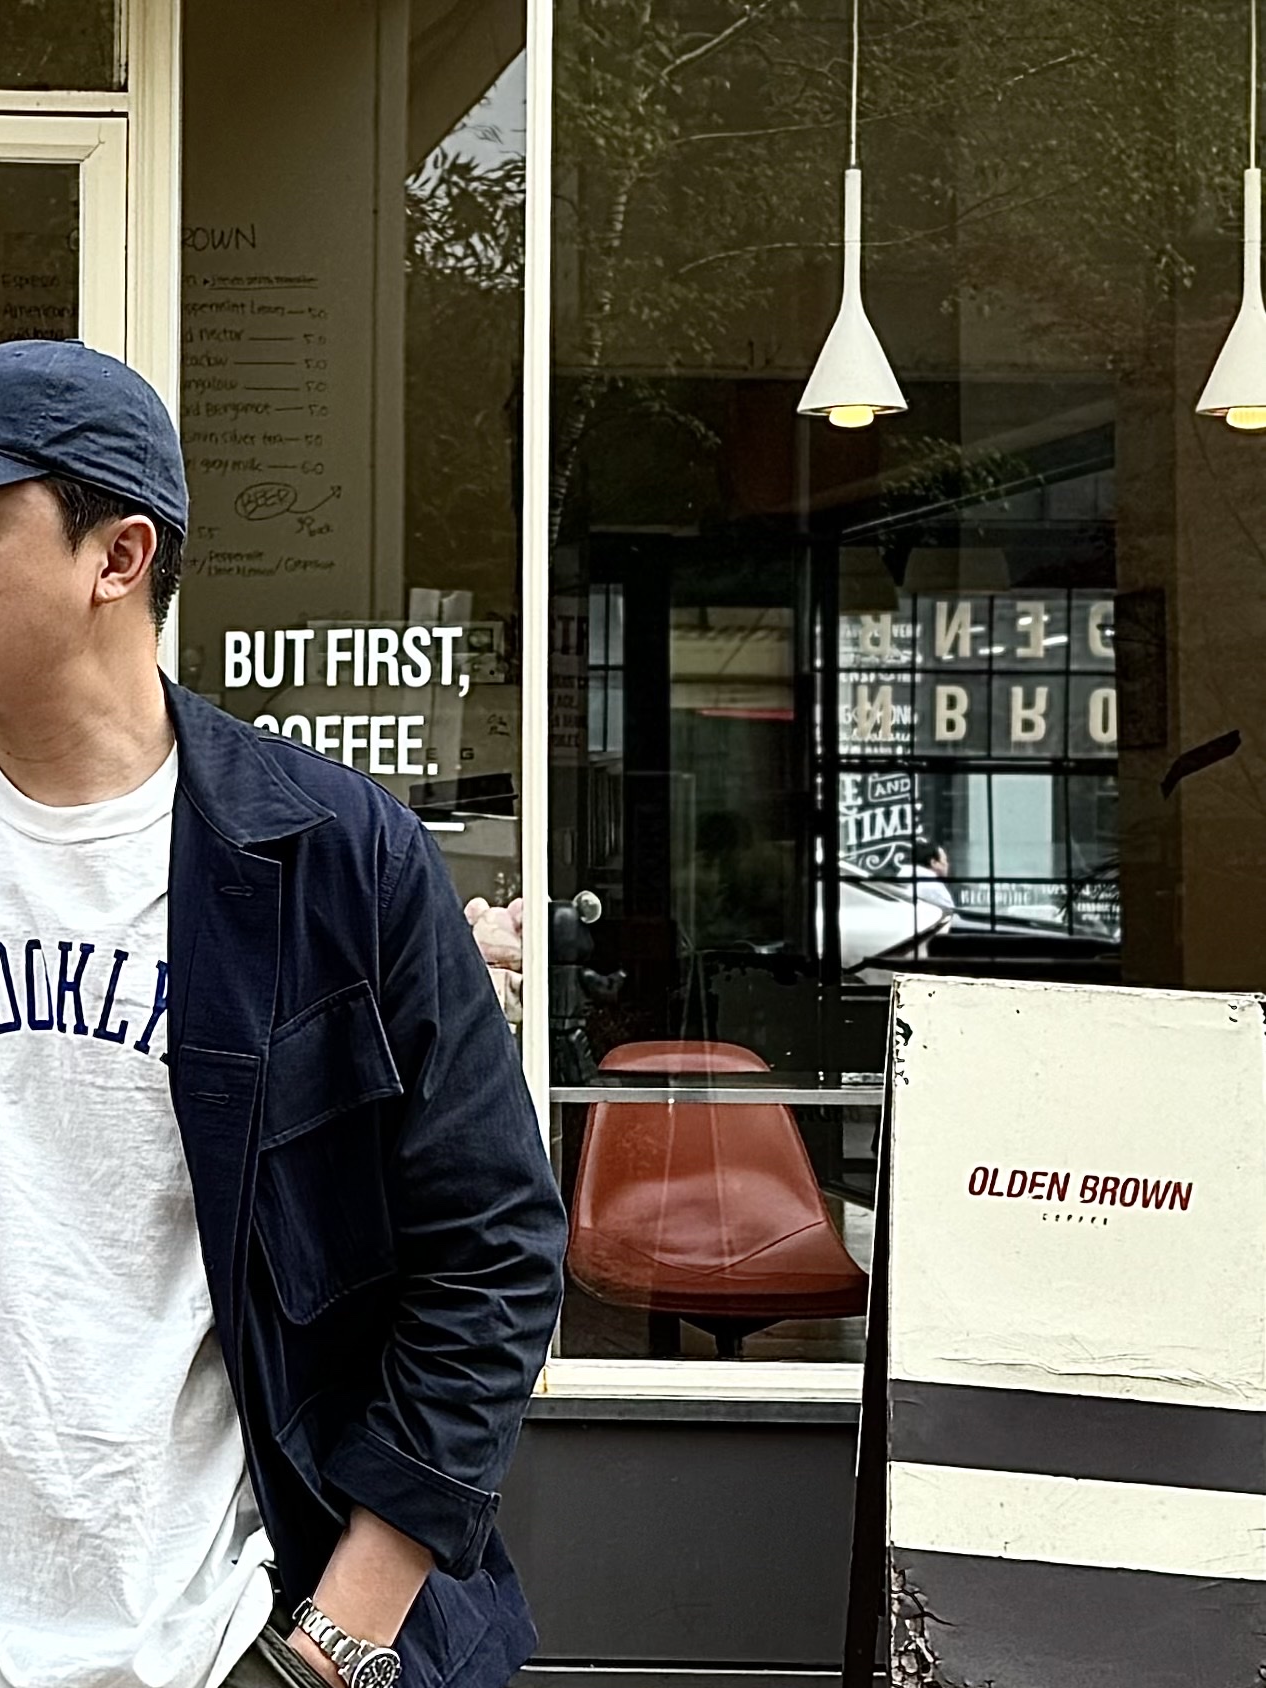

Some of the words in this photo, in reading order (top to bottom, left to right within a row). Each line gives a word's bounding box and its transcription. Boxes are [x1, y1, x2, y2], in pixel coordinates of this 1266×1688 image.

[225, 630, 314, 688] BUT
[327, 627, 470, 697] FIRST,
[968, 1166, 1070, 1202] OLDEN
[1079, 1175, 1193, 1211] BROWN
